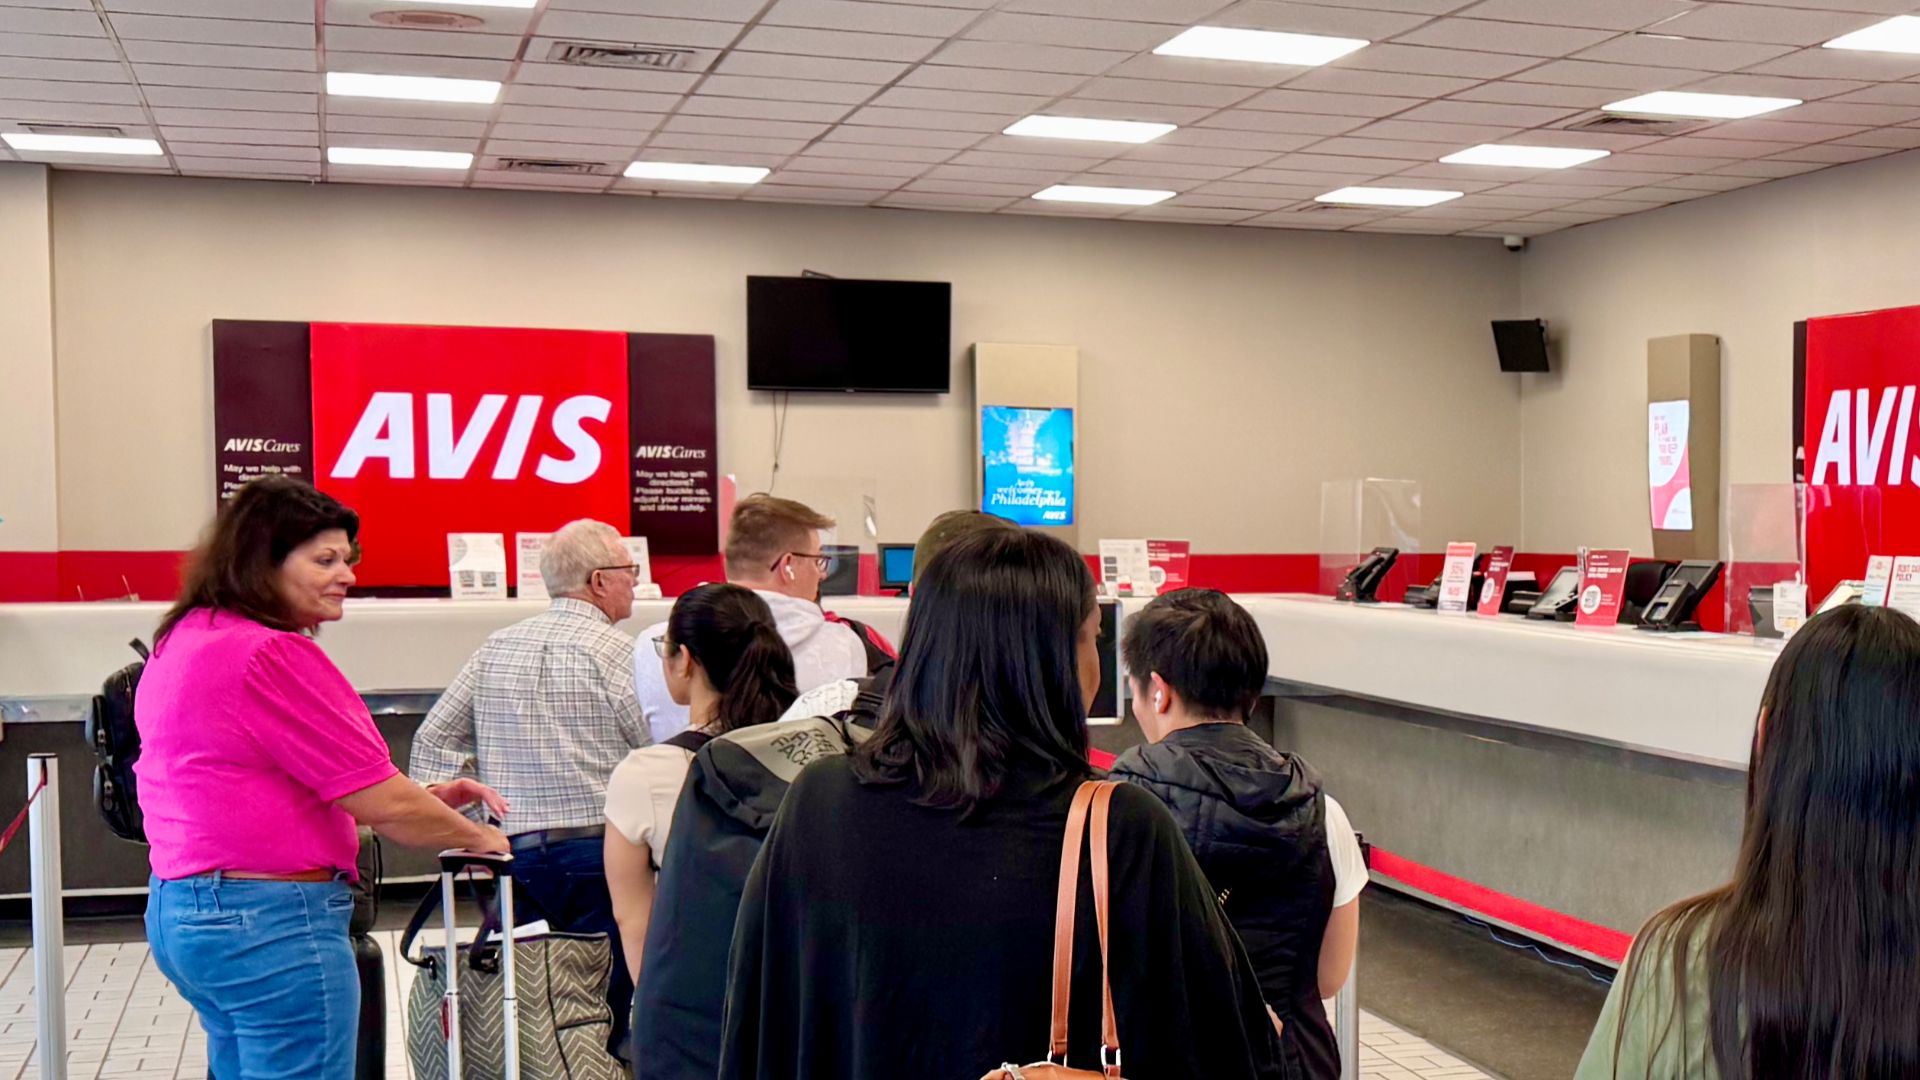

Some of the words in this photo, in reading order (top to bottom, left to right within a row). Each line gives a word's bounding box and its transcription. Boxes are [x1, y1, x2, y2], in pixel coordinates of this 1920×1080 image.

[329, 391, 613, 485] AVIS
[1811, 384, 1920, 488] AVI
[223, 464, 243, 473] May
[245, 465, 259, 473] we
[261, 464, 281, 473] help
[282, 464, 302, 473] with
[635, 469, 654, 479] May
[669, 470, 689, 479] help
[690, 470, 708, 478] with
[648, 478, 695, 487] directions?
[635, 486, 664, 495] Please
[665, 486, 694, 495] buckle
[633, 496, 660, 504] adjust
[660, 496, 680, 505] your
[990, 493, 1067, 508] Philadelphia
[639, 504, 656, 512] and
[656, 504, 679, 512] drive
[1042, 510, 1067, 520] AVIS
